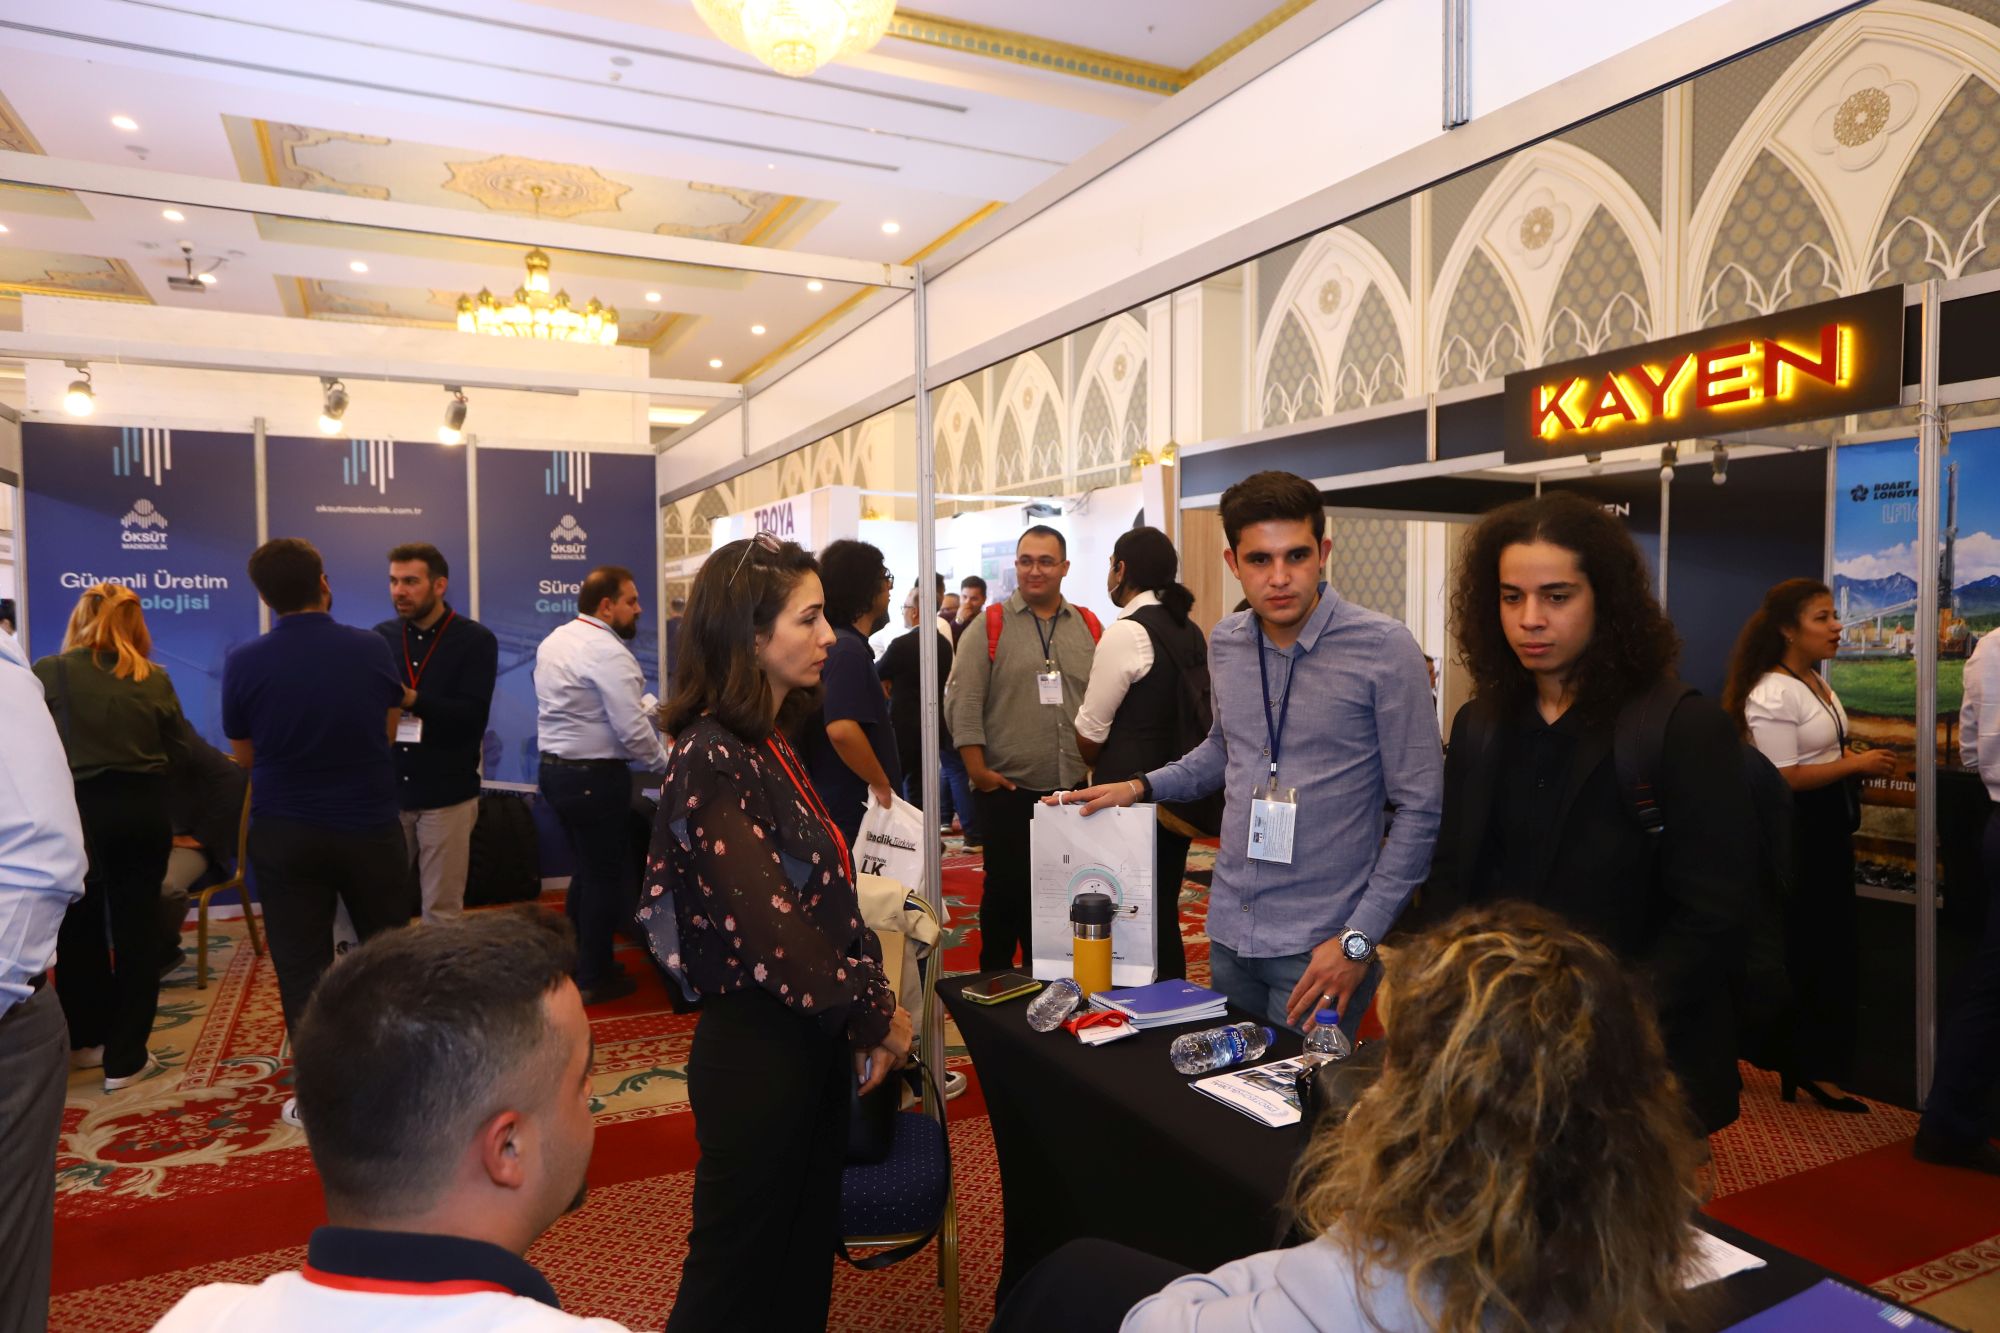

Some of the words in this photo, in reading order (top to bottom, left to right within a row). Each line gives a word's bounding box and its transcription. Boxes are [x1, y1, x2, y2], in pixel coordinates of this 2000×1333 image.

[1531, 323, 1846, 439] KAYEN
[1873, 480, 1911, 492] BOART
[1873, 487, 1919, 500] LONGYE
[754, 502, 794, 536] TROYA
[121, 530, 168, 543] ÖKSÜT
[550, 543, 587, 553] ÖKSÜT
[154, 569, 228, 589] Üretim
[538, 580, 584, 594] Süre
[1890, 780, 1916, 792] FUTU
